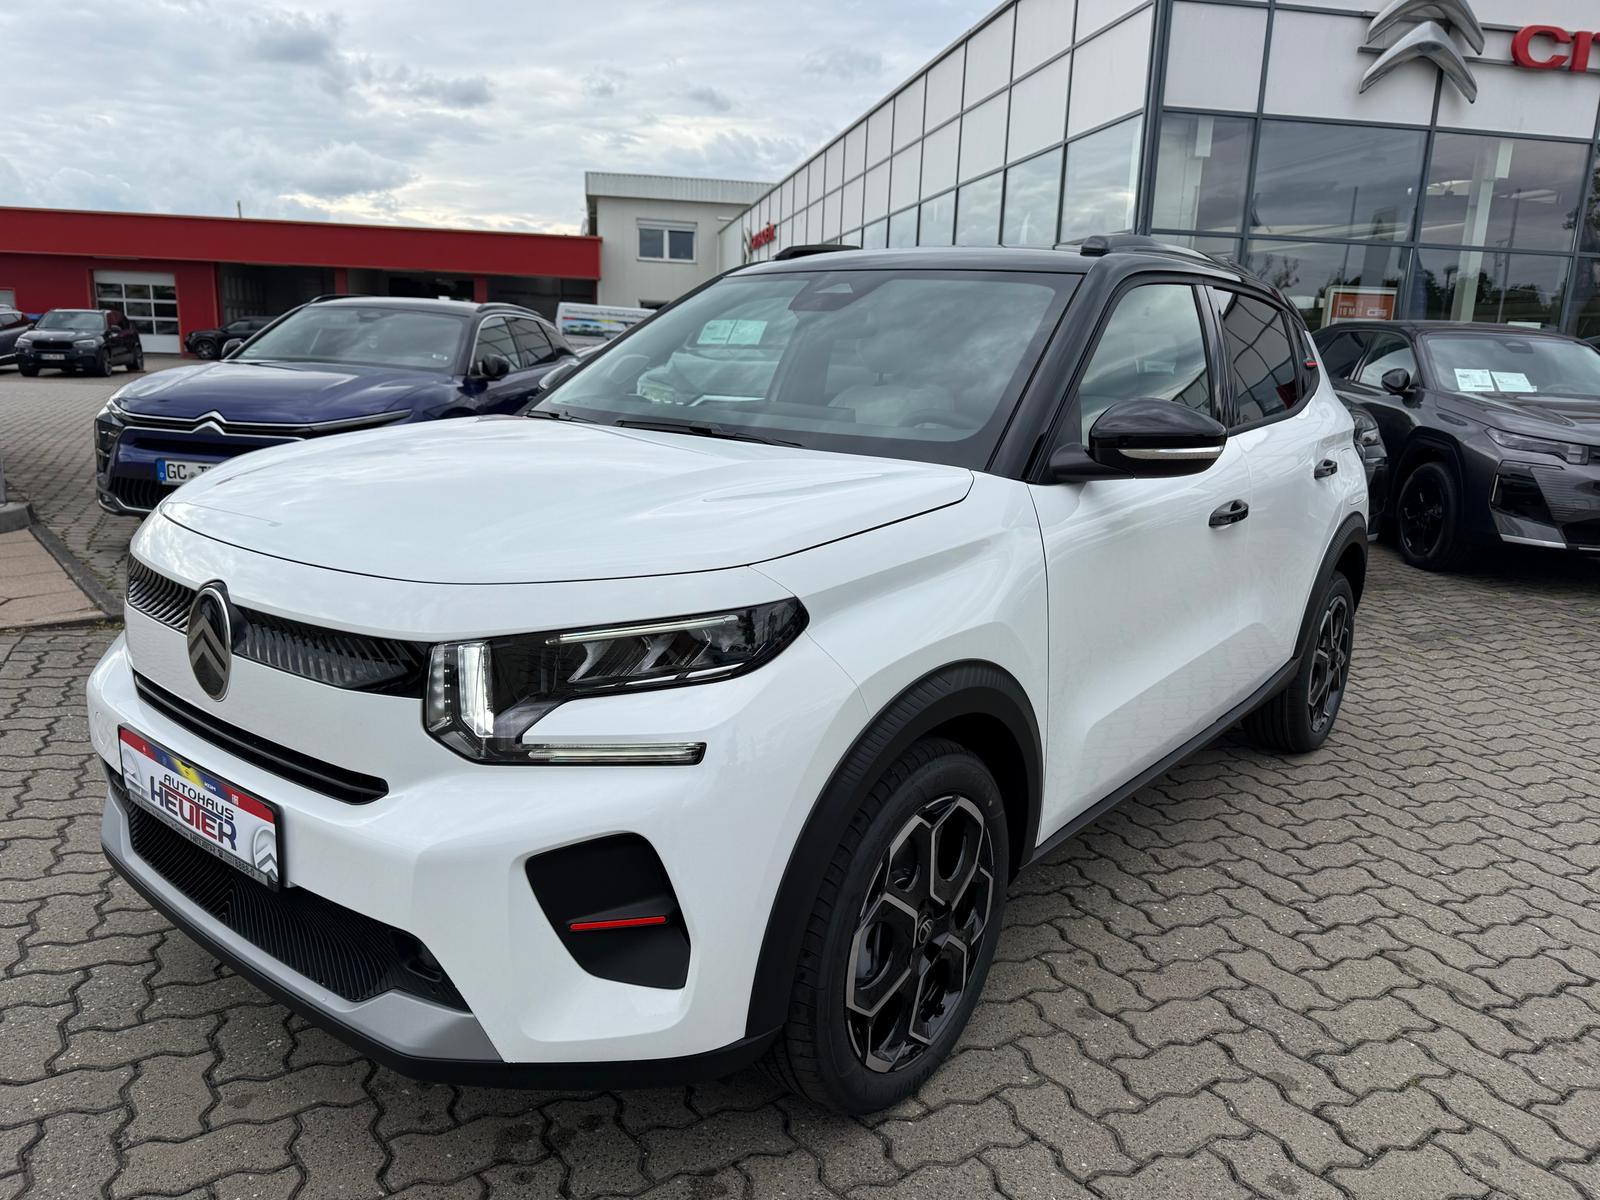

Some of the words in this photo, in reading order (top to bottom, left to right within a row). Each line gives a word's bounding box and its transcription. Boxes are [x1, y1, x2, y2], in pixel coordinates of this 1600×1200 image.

[1511, 24, 1600, 73] CI
[166, 463, 187, 480] GC
[150, 776, 237, 851] HEUTER
[164, 774, 234, 821] AUTOHAUS
